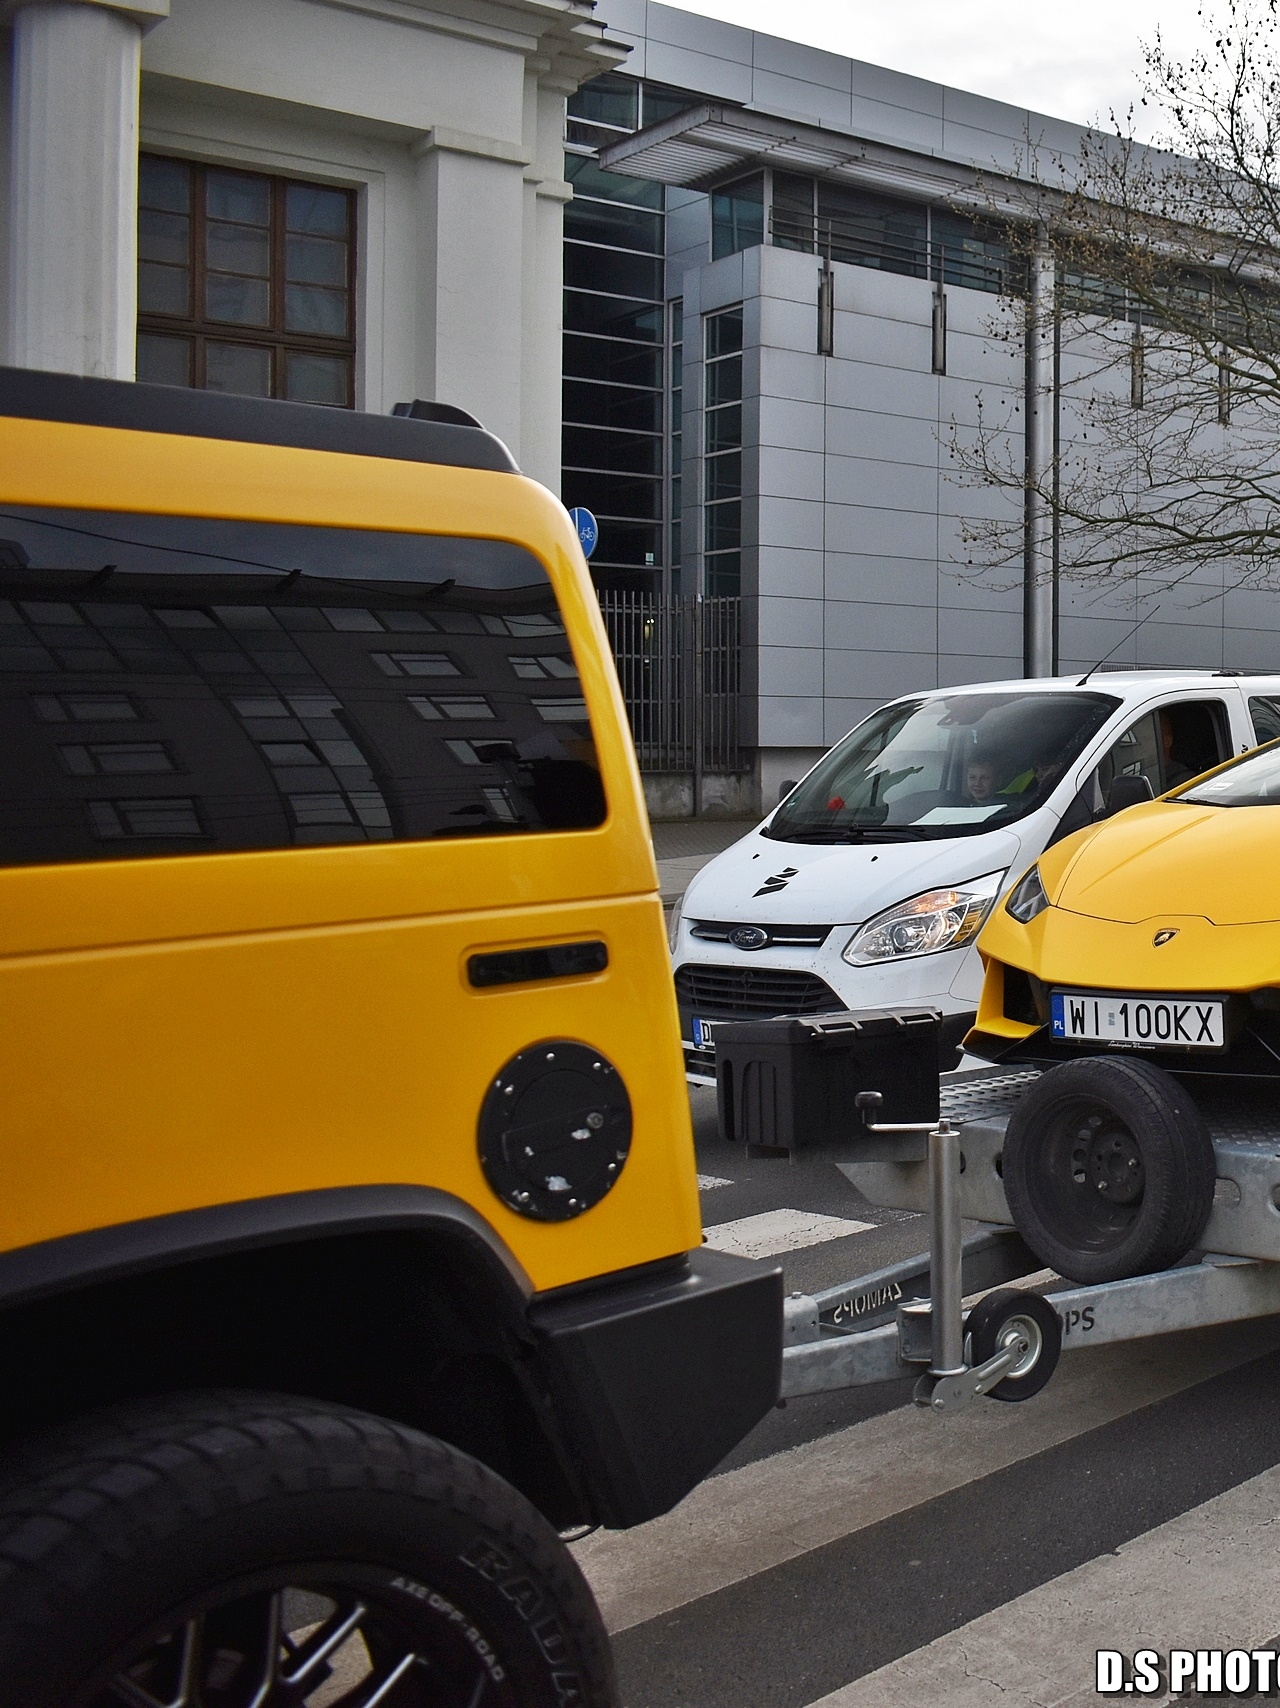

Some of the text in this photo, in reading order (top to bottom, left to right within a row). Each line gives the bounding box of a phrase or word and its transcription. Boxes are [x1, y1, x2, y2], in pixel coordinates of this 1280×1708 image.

[735, 930, 757, 943] Ford
[701, 1022, 711, 1042] D
[1054, 1000, 1215, 1043] PL WI 100KX
[1065, 1306, 1095, 1335] PS
